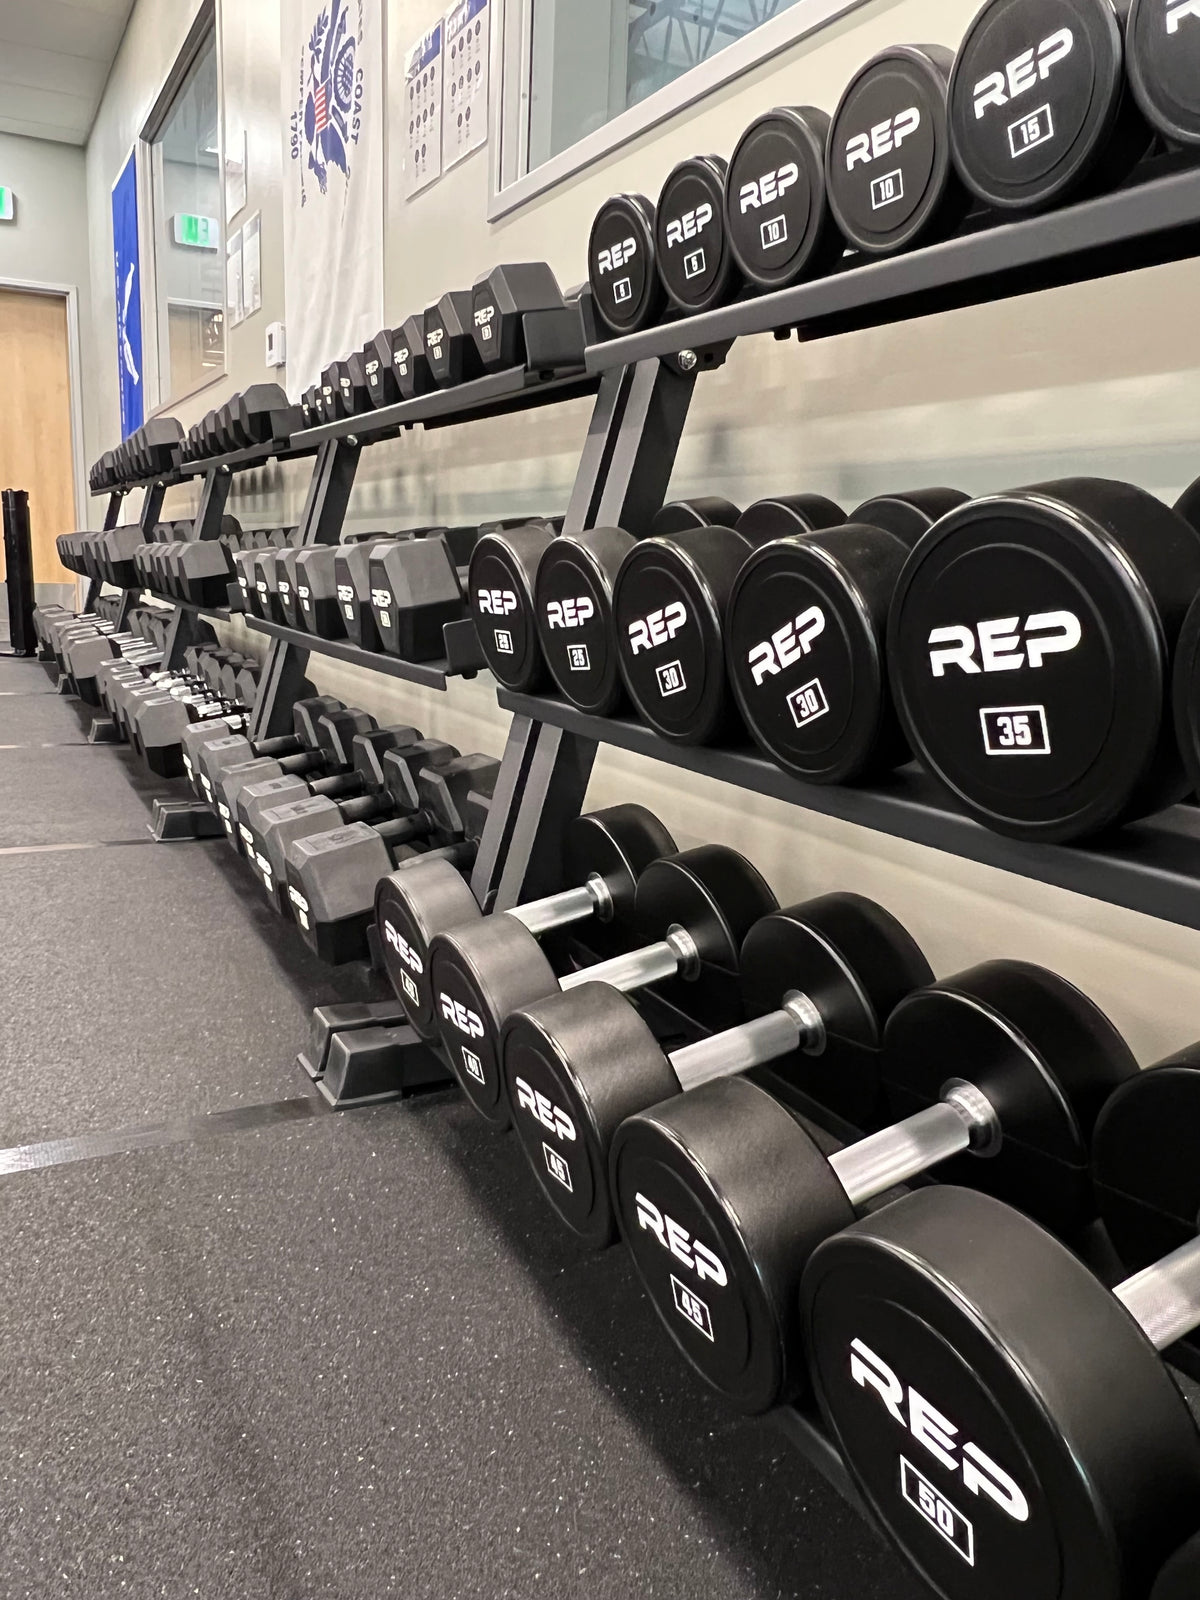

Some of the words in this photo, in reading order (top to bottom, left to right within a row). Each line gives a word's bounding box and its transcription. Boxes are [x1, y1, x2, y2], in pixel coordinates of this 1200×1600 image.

[973, 27, 1073, 119] REP
[351, 67, 363, 145] COAST
[290, 111, 299, 159] 1790
[845, 107, 920, 171] REP
[1020, 117, 1040, 144] 15
[739, 162, 799, 214] REP
[879, 178, 894, 200] 10
[666, 202, 713, 248] REP
[767, 222, 780, 242] 10
[598, 237, 637, 275] REP
[427, 328, 444, 347] REP
[474, 305, 495, 327] REP
[478, 589, 517, 615] REP
[546, 596, 594, 629] REP
[628, 601, 687, 655] REP
[748, 605, 825, 686] REP
[928, 610, 1082, 677] REP
[571, 649, 586, 667] 25
[662, 668, 677, 689] 30
[799, 687, 818, 718] 30
[996, 716, 1032, 746] 35
[384, 920, 424, 974] REP
[440, 992, 485, 1039] REP
[516, 1076, 577, 1141] REP
[550, 1153, 566, 1181] 45
[635, 1192, 728, 1287] REP
[681, 1288, 702, 1326] 45
[850, 1337, 1029, 1522] REP
[919, 1480, 954, 1537] 50
